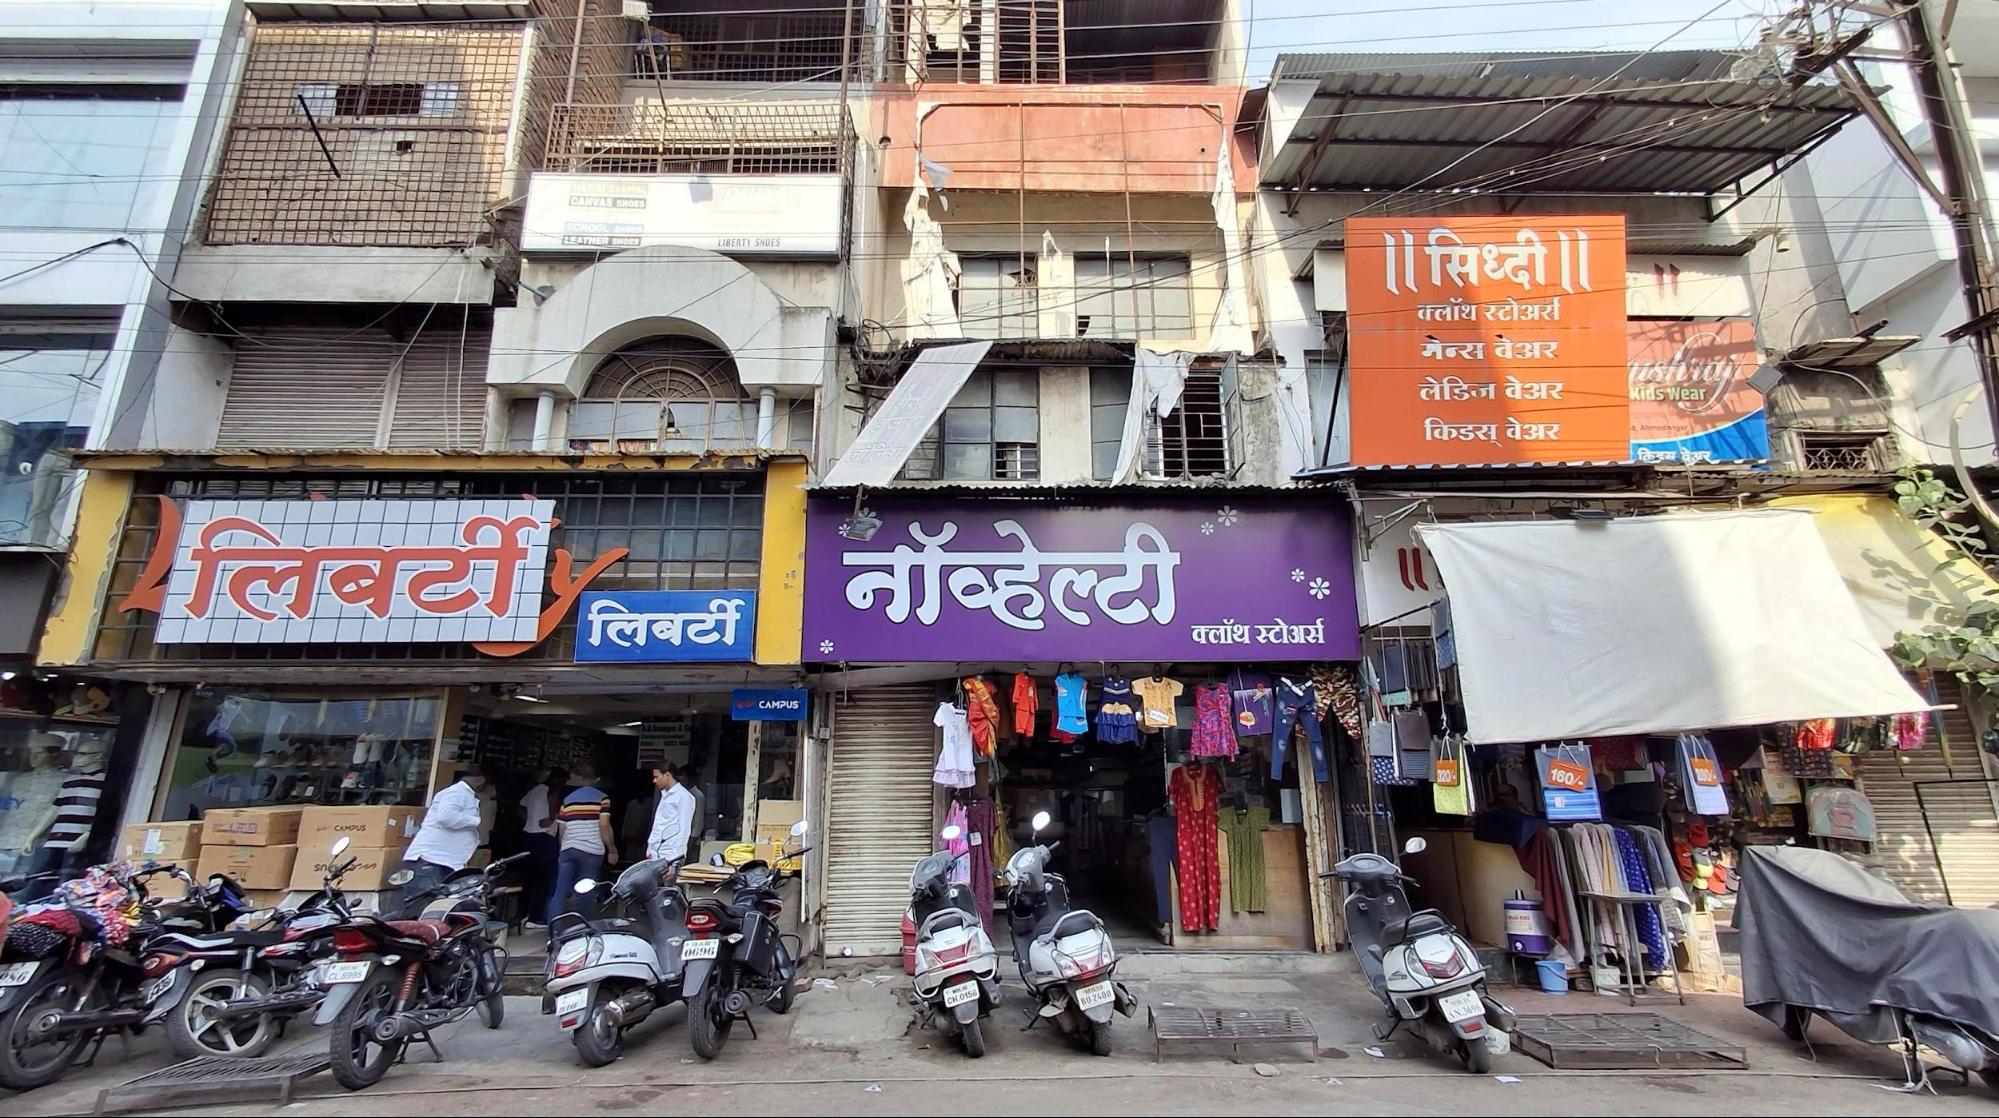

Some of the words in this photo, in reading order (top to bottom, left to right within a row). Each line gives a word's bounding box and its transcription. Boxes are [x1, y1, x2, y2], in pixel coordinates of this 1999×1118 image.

[570, 197, 613, 207] CANVAS
[615, 199, 645, 208] SHOES
[566, 223, 608, 233] SCHOOL
[718, 238, 751, 247] LIBERTY
[755, 238, 781, 247] SHOES
[1416, 297, 1477, 321] क्लॉथ
[1494, 337, 1560, 359] वेअर
[1504, 375, 1564, 400] वेअर
[1630, 387, 1666, 401] Kids
[1667, 387, 1706, 401] Wear
[1505, 416, 1560, 440] वेअर
[184, 516, 540, 622] लिबर्टी
[587, 598, 746, 647] लिबर्टी
[1190, 617, 1250, 645] क्लॉथ
[758, 700, 799, 710] CAMPUS
[1552, 767, 1584, 786] 160/-
[334, 824, 367, 832] CAMPUS
